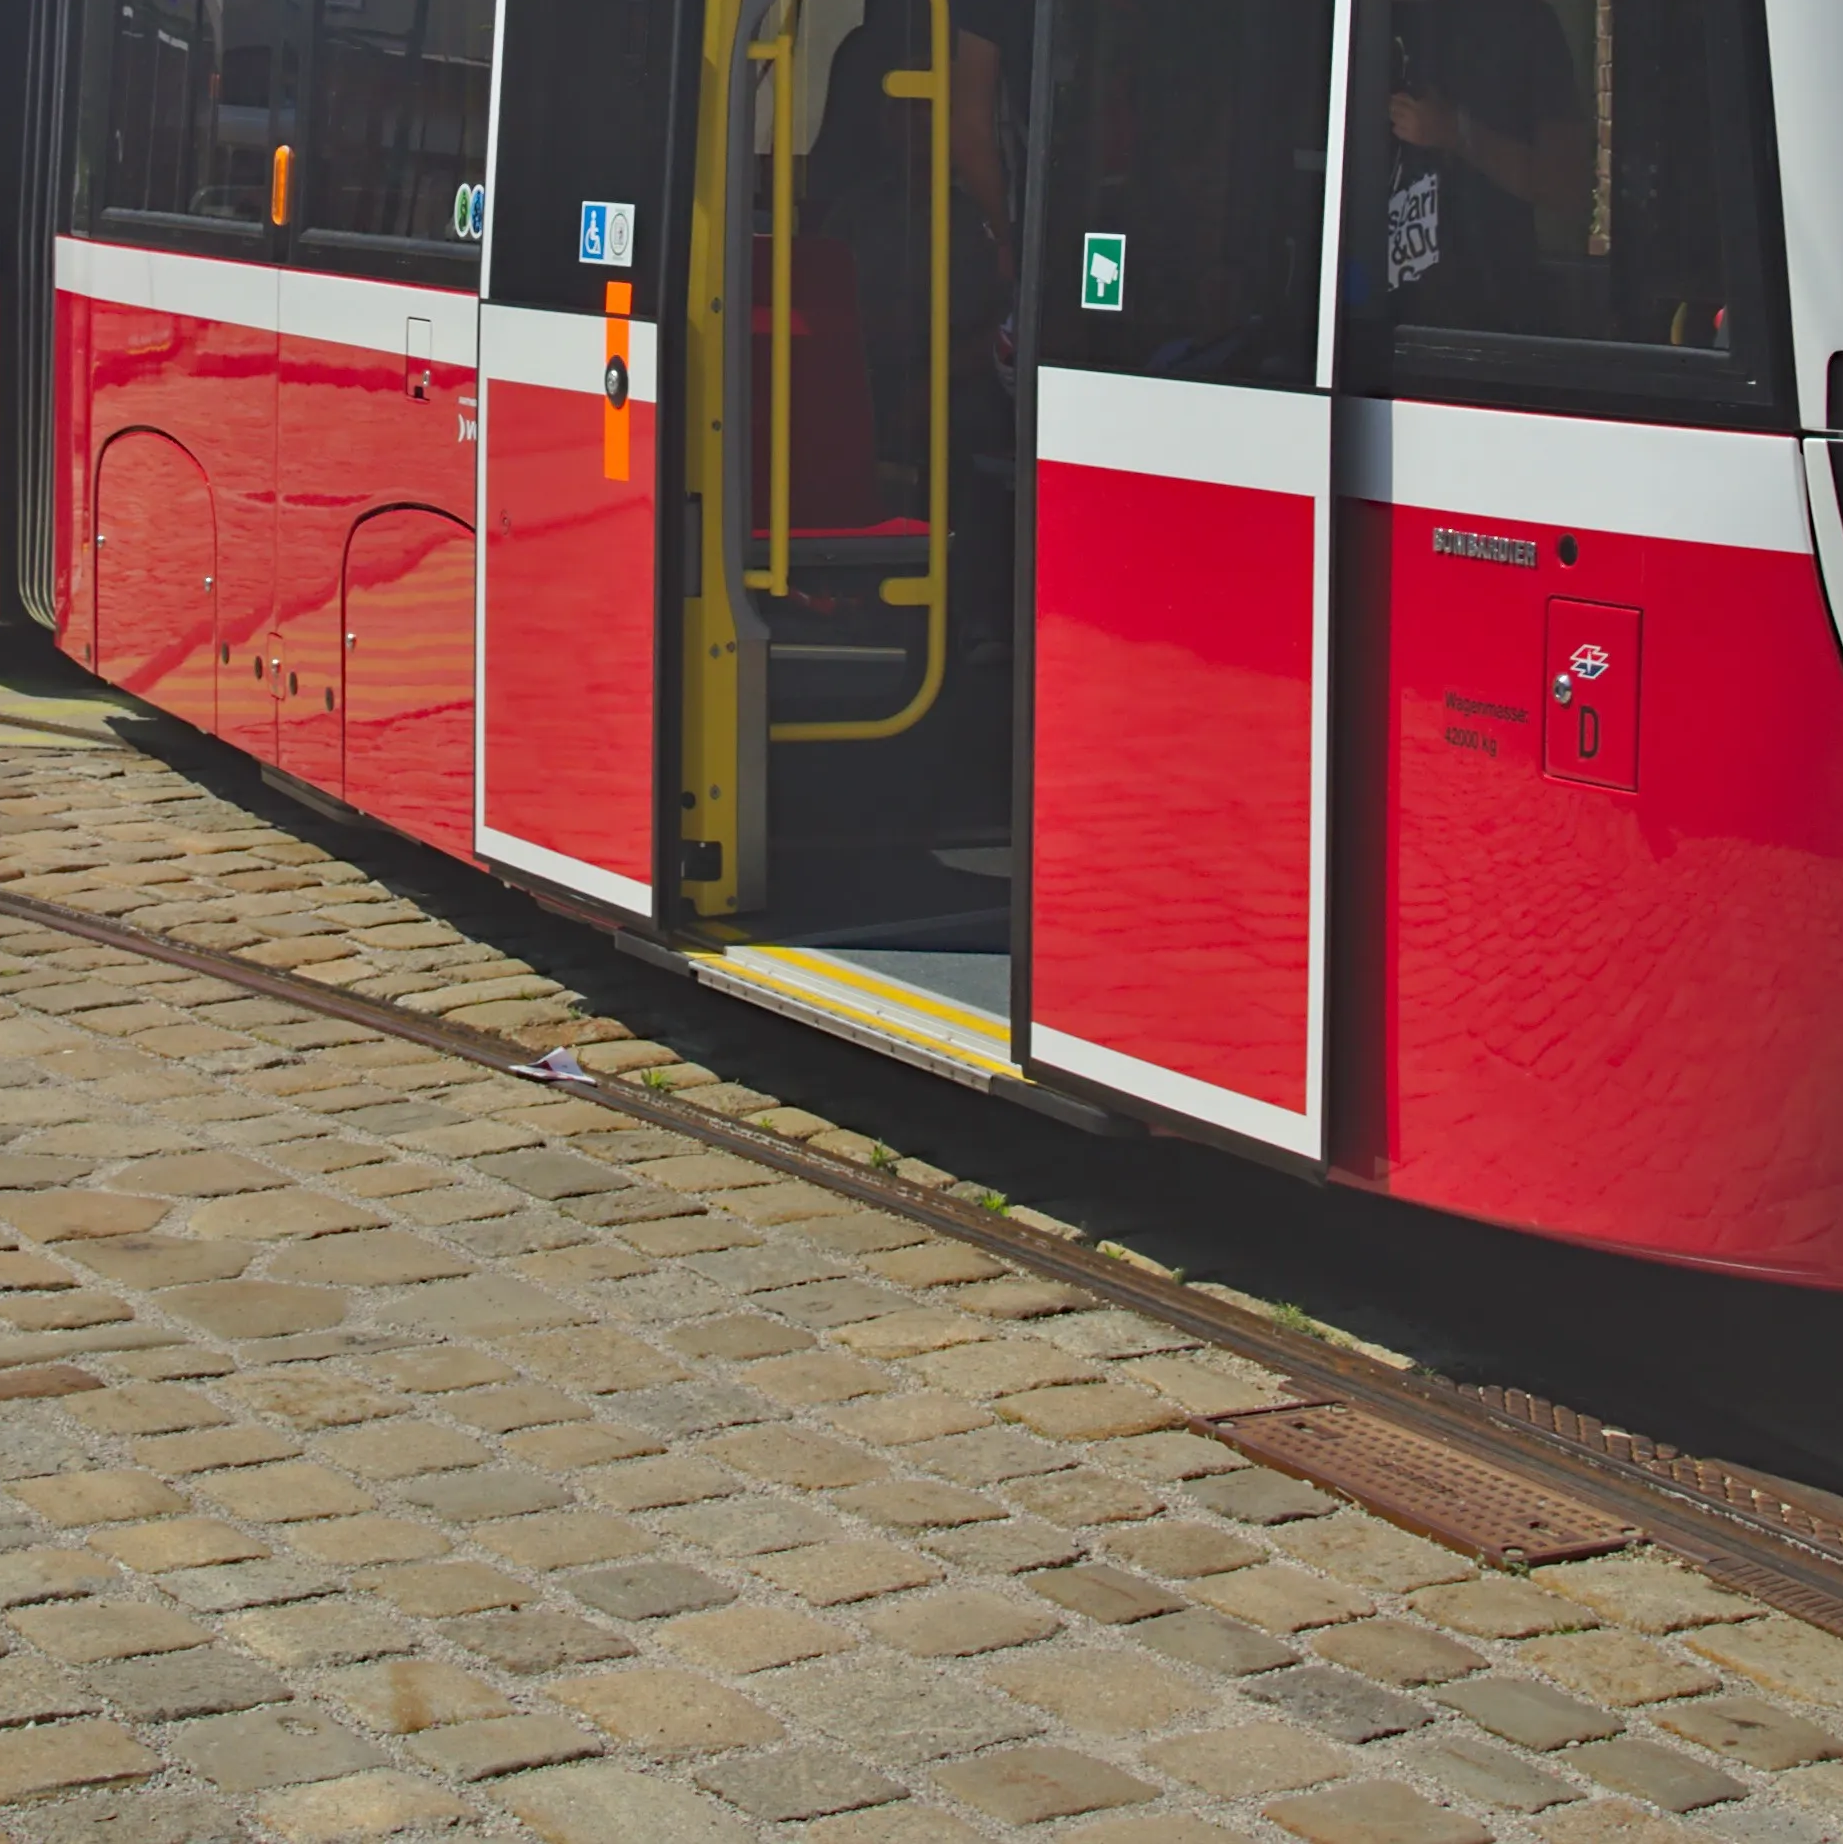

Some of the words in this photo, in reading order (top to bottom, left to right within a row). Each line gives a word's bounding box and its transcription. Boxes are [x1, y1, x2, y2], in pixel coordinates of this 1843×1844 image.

[1433, 527, 1537, 568] BOMBARDIER
[1482, 734, 1498, 758] kg
[1578, 705, 1599, 760] D
